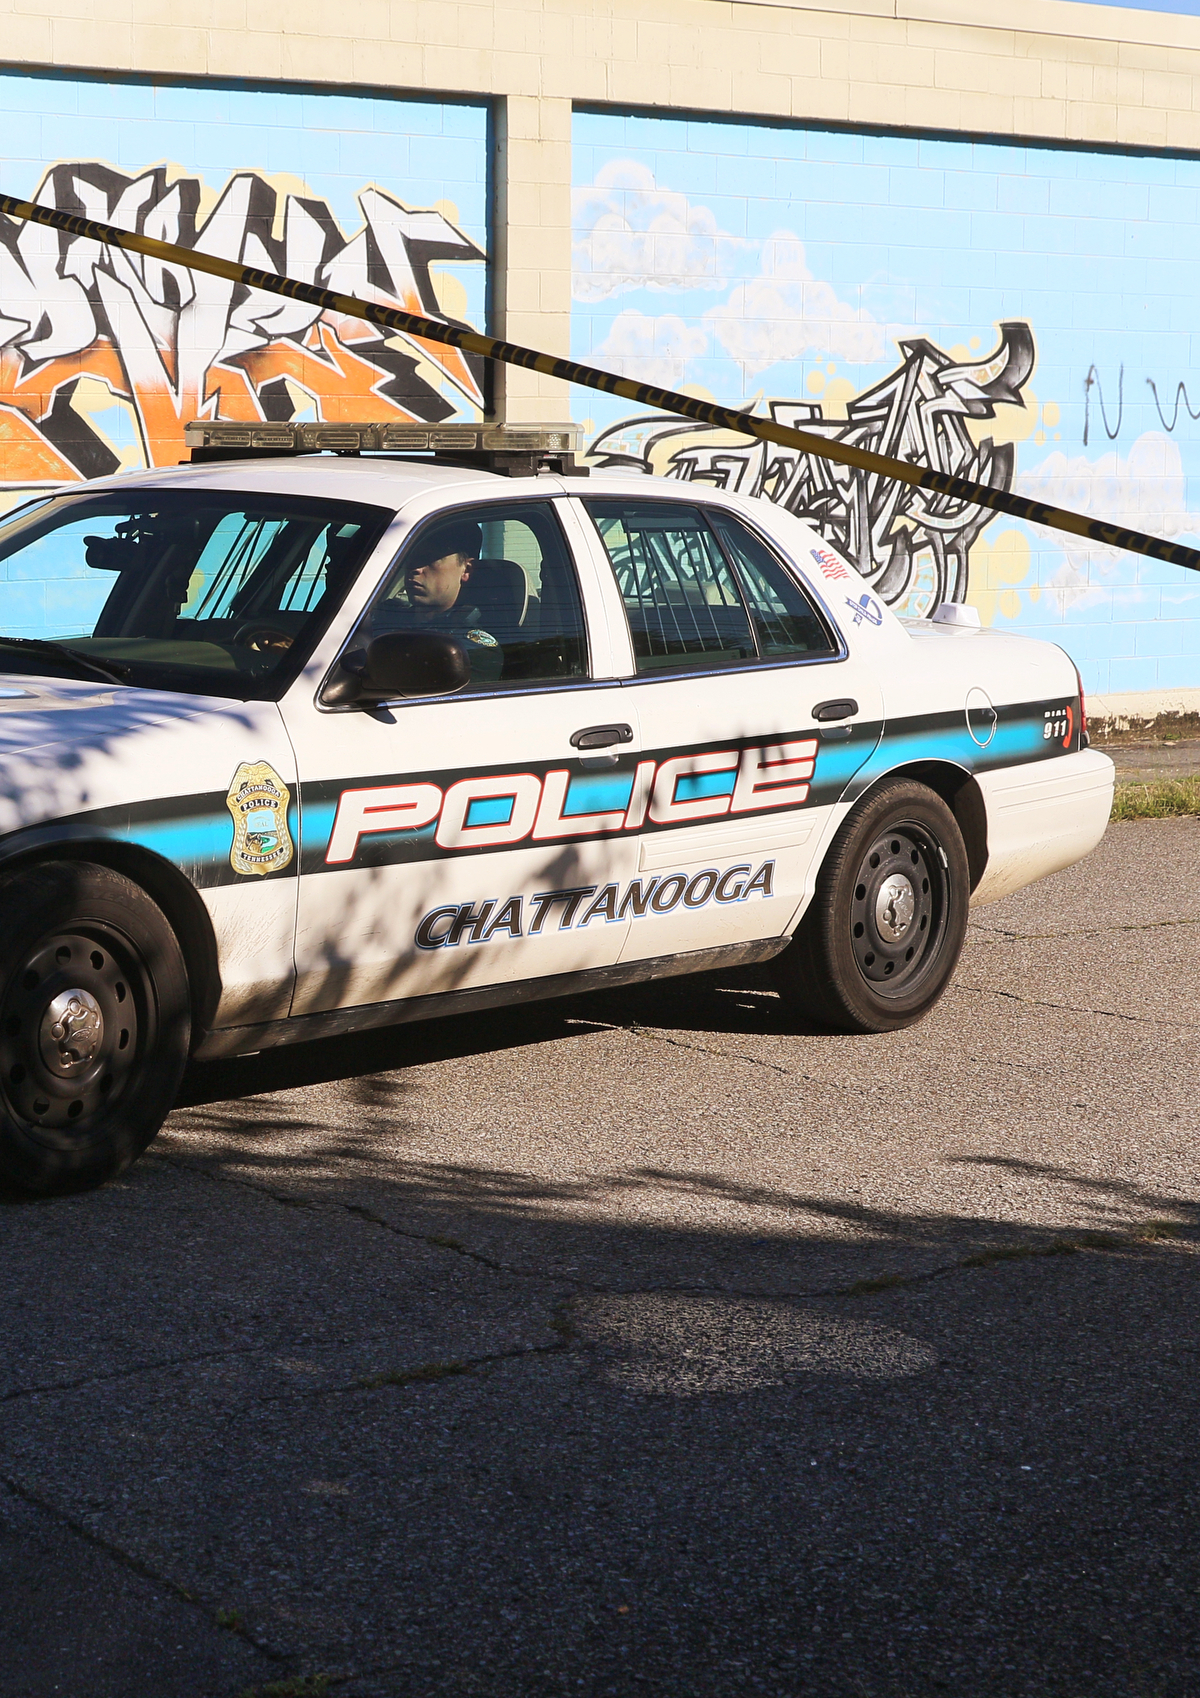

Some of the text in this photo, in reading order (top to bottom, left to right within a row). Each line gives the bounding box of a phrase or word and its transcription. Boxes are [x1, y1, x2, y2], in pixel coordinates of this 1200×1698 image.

[1044, 708, 1067, 718] DIAL
[1043, 719, 1067, 739] 911
[237, 785, 281, 801] CHATTANOOGA
[242, 798, 277, 812] POLICE
[325, 739, 819, 864] POLICE
[242, 849, 282, 863] TENNESSEE
[415, 860, 776, 949] CHATTANOOGA
